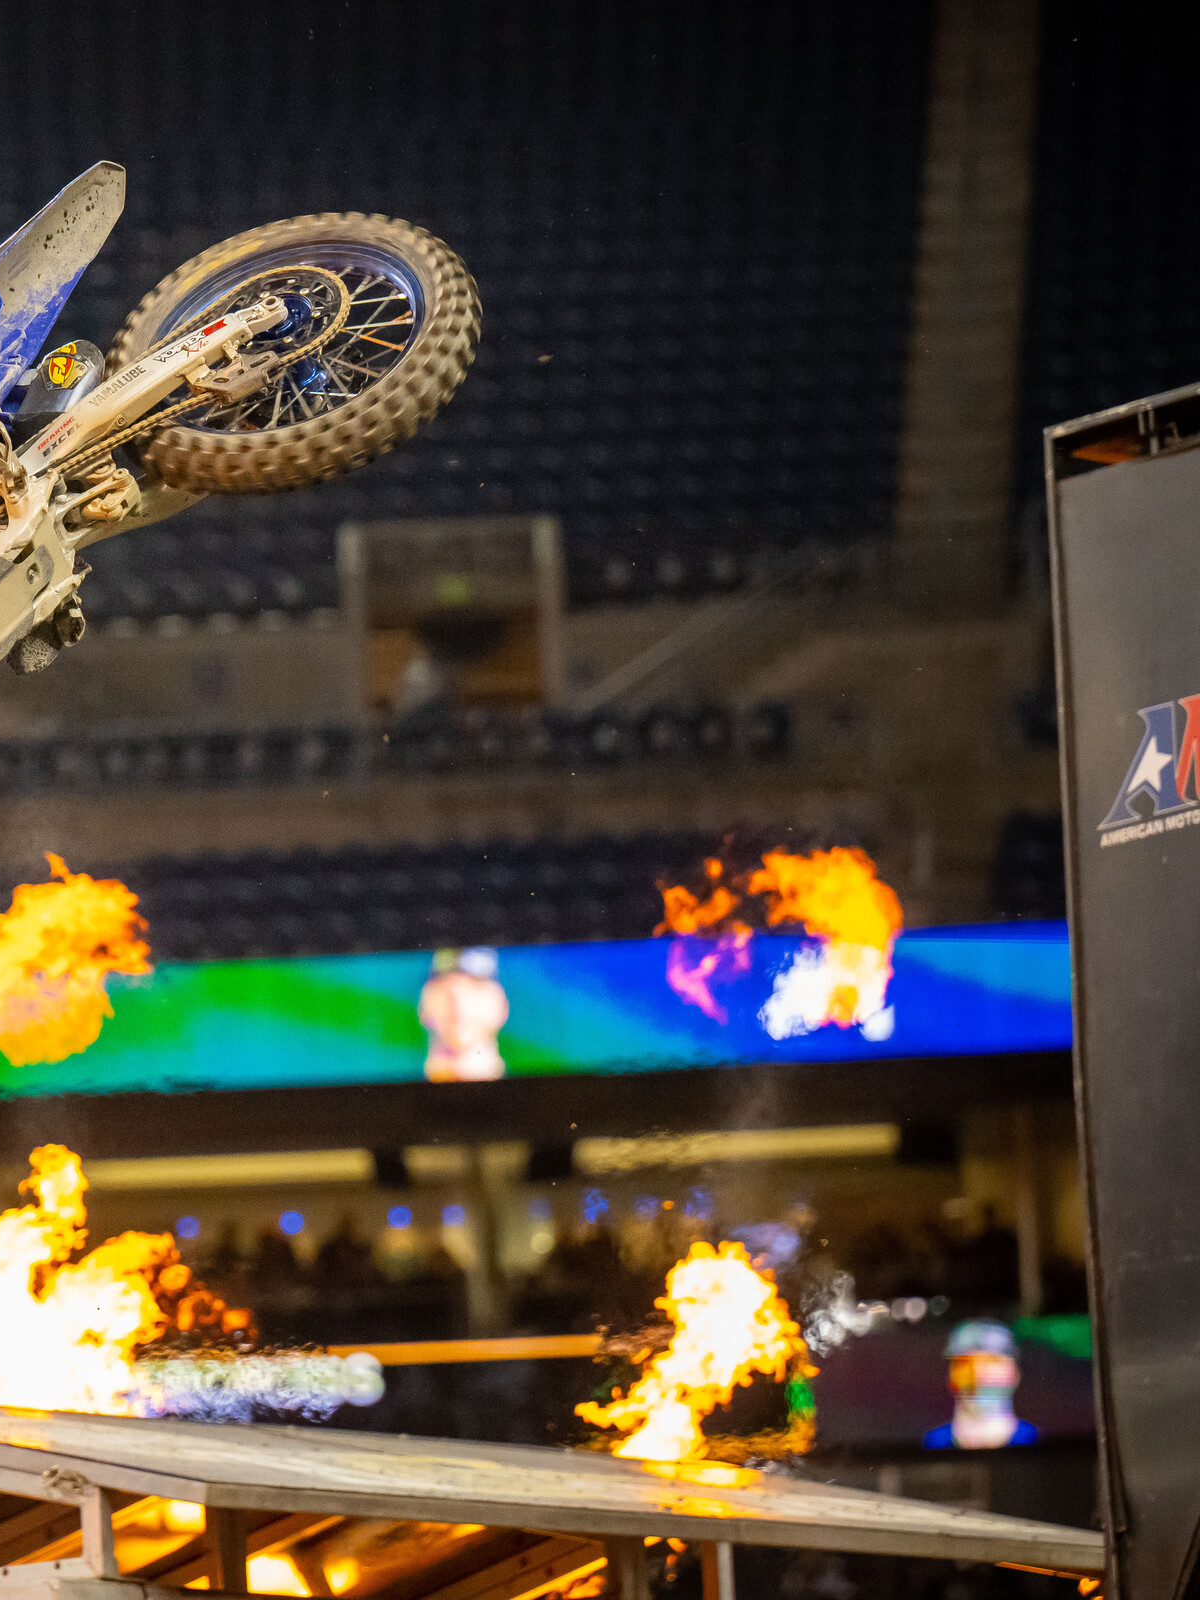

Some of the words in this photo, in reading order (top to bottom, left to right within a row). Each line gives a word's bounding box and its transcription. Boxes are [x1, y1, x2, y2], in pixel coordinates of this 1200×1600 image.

[89, 365, 147, 407] YAMALUBE
[37, 416, 76, 451] BRAKING
[42, 422, 83, 458] EXCEL
[1100, 818, 1165, 849] AMERICAN
